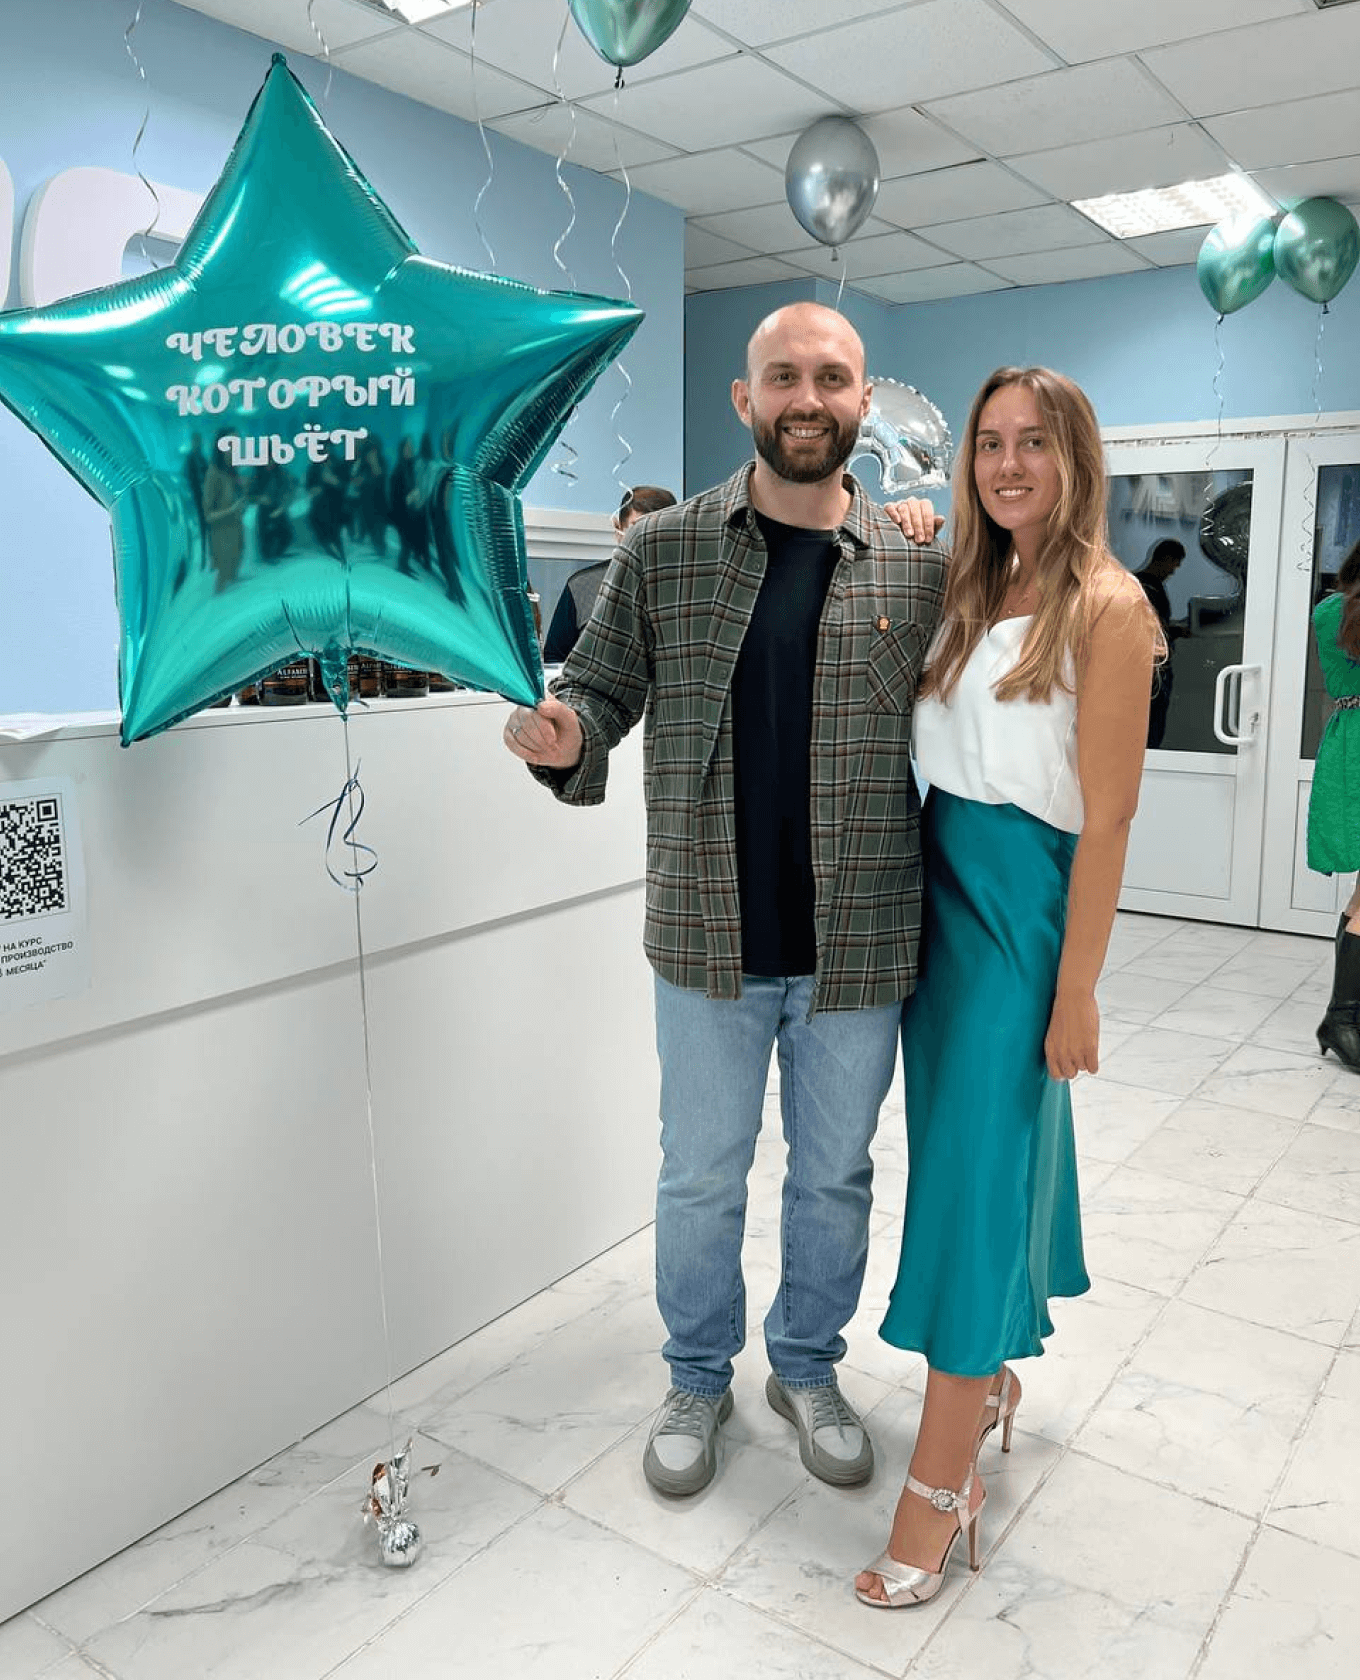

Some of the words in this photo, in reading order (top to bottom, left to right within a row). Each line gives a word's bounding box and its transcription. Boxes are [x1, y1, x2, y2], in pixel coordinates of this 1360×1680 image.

[165, 321, 416, 361] ЧЕЛОВЕК
[165, 366, 416, 417] КОТОРЫЙ
[217, 423, 368, 467] ШЬЁТ
[0, 940, 74, 964] ПРОИЗВОДСТВО
[3, 942, 17, 952] НА
[17, 936, 43, 949] КУРС
